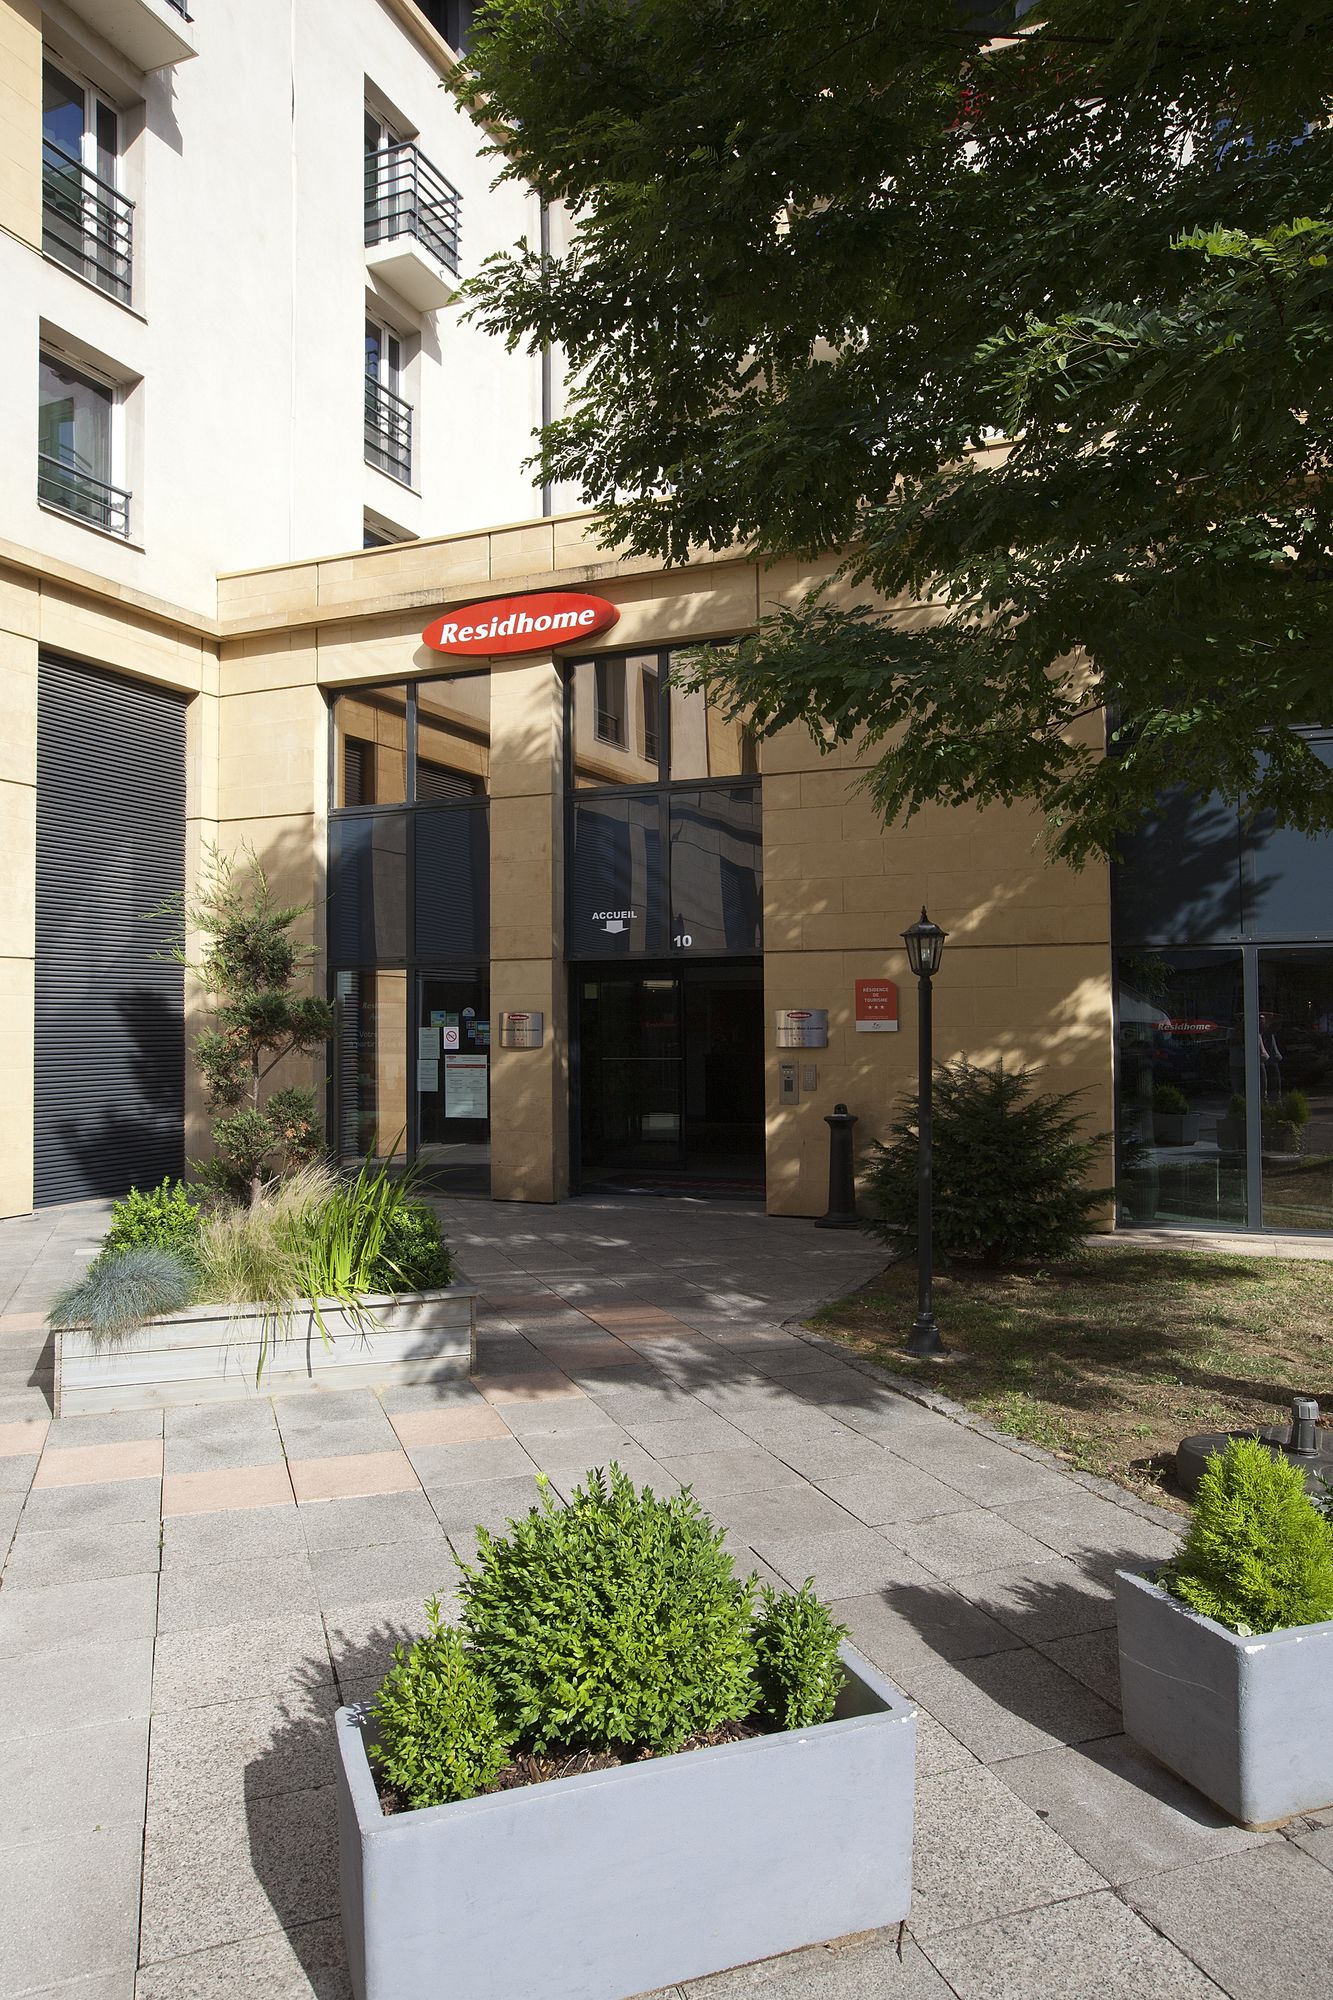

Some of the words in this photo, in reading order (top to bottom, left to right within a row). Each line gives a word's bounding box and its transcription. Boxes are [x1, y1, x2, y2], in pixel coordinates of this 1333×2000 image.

[440, 609, 595, 645] Residhome
[592, 910, 638, 920] ACCUEIL
[673, 934, 693, 947] 10
[1157, 1023, 1211, 1031] Residhome
